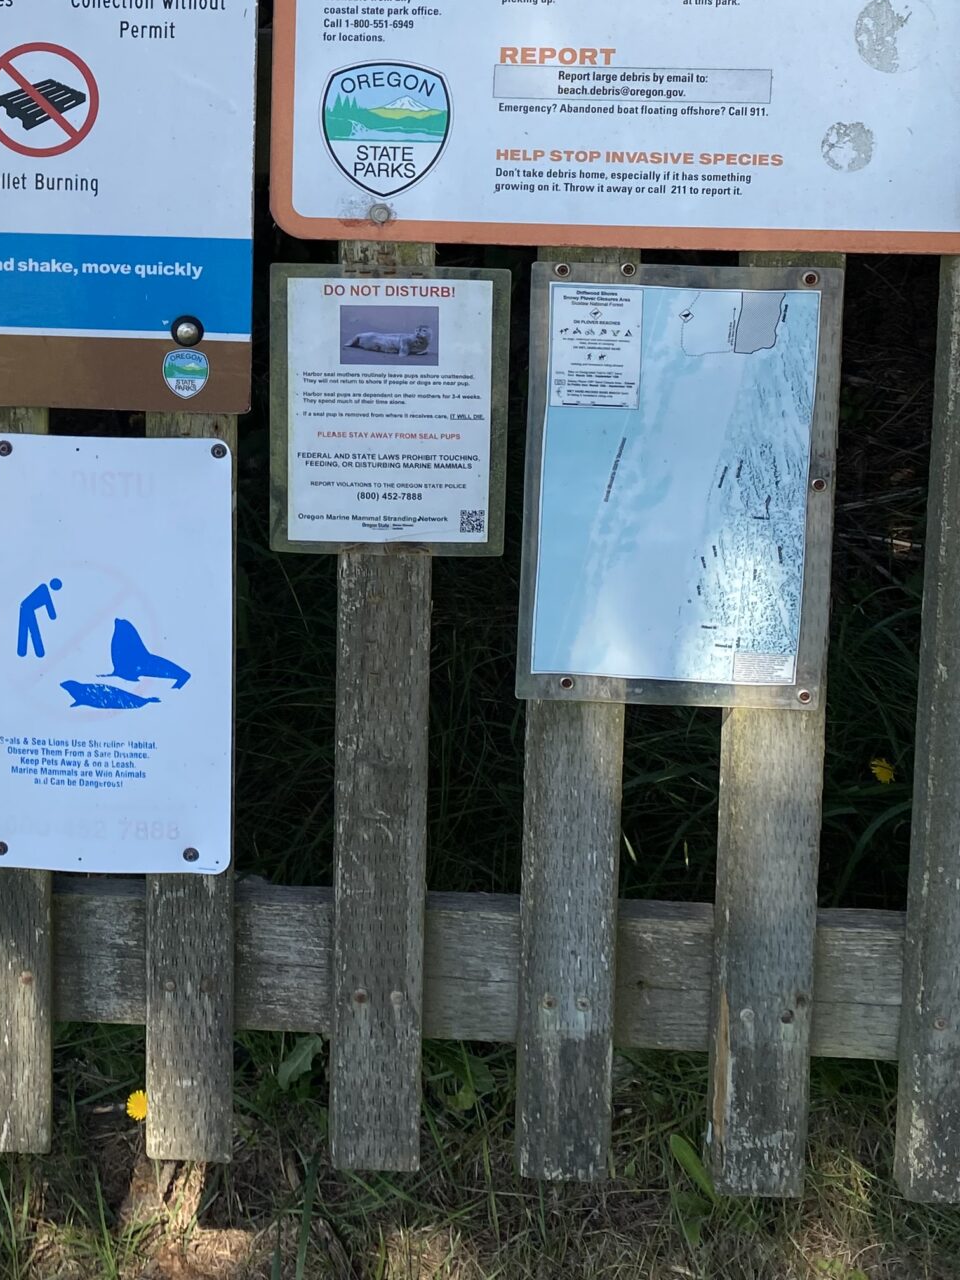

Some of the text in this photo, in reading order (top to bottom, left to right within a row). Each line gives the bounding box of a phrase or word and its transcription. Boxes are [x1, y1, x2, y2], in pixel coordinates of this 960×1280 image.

[119, 20, 175, 38] Permit
[323, 18, 413, 28] Call 1-800-551-6949
[500, 47, 616, 64] REPORT
[340, 72, 435, 96] OREGON
[558, 70, 707, 84] Report large debris by email to:
[557, 85, 685, 99] beach.debris@oregon.gov.
[356, 145, 414, 161] STATE
[495, 148, 783, 166] HELP STOP INVASIVE SPECIES
[354, 162, 416, 178] PARKS
[35, 172, 98, 196] Burning
[17, 258, 78, 276] shake,
[81, 262, 131, 274] move
[134, 261, 203, 279] quickly
[323, 284, 455, 297] DO NOT DISTURB!
[170, 354, 202, 363] OREGON
[297, 451, 331, 459] FEDERAL
[356, 491, 422, 501] (800) 452-7888
[20, 756, 39, 766] Keep
[41, 757, 58, 766] Pets
[60, 758, 81, 766] Away
[83, 759, 89, 767] &
[111, 760, 136, 768] Leash.
